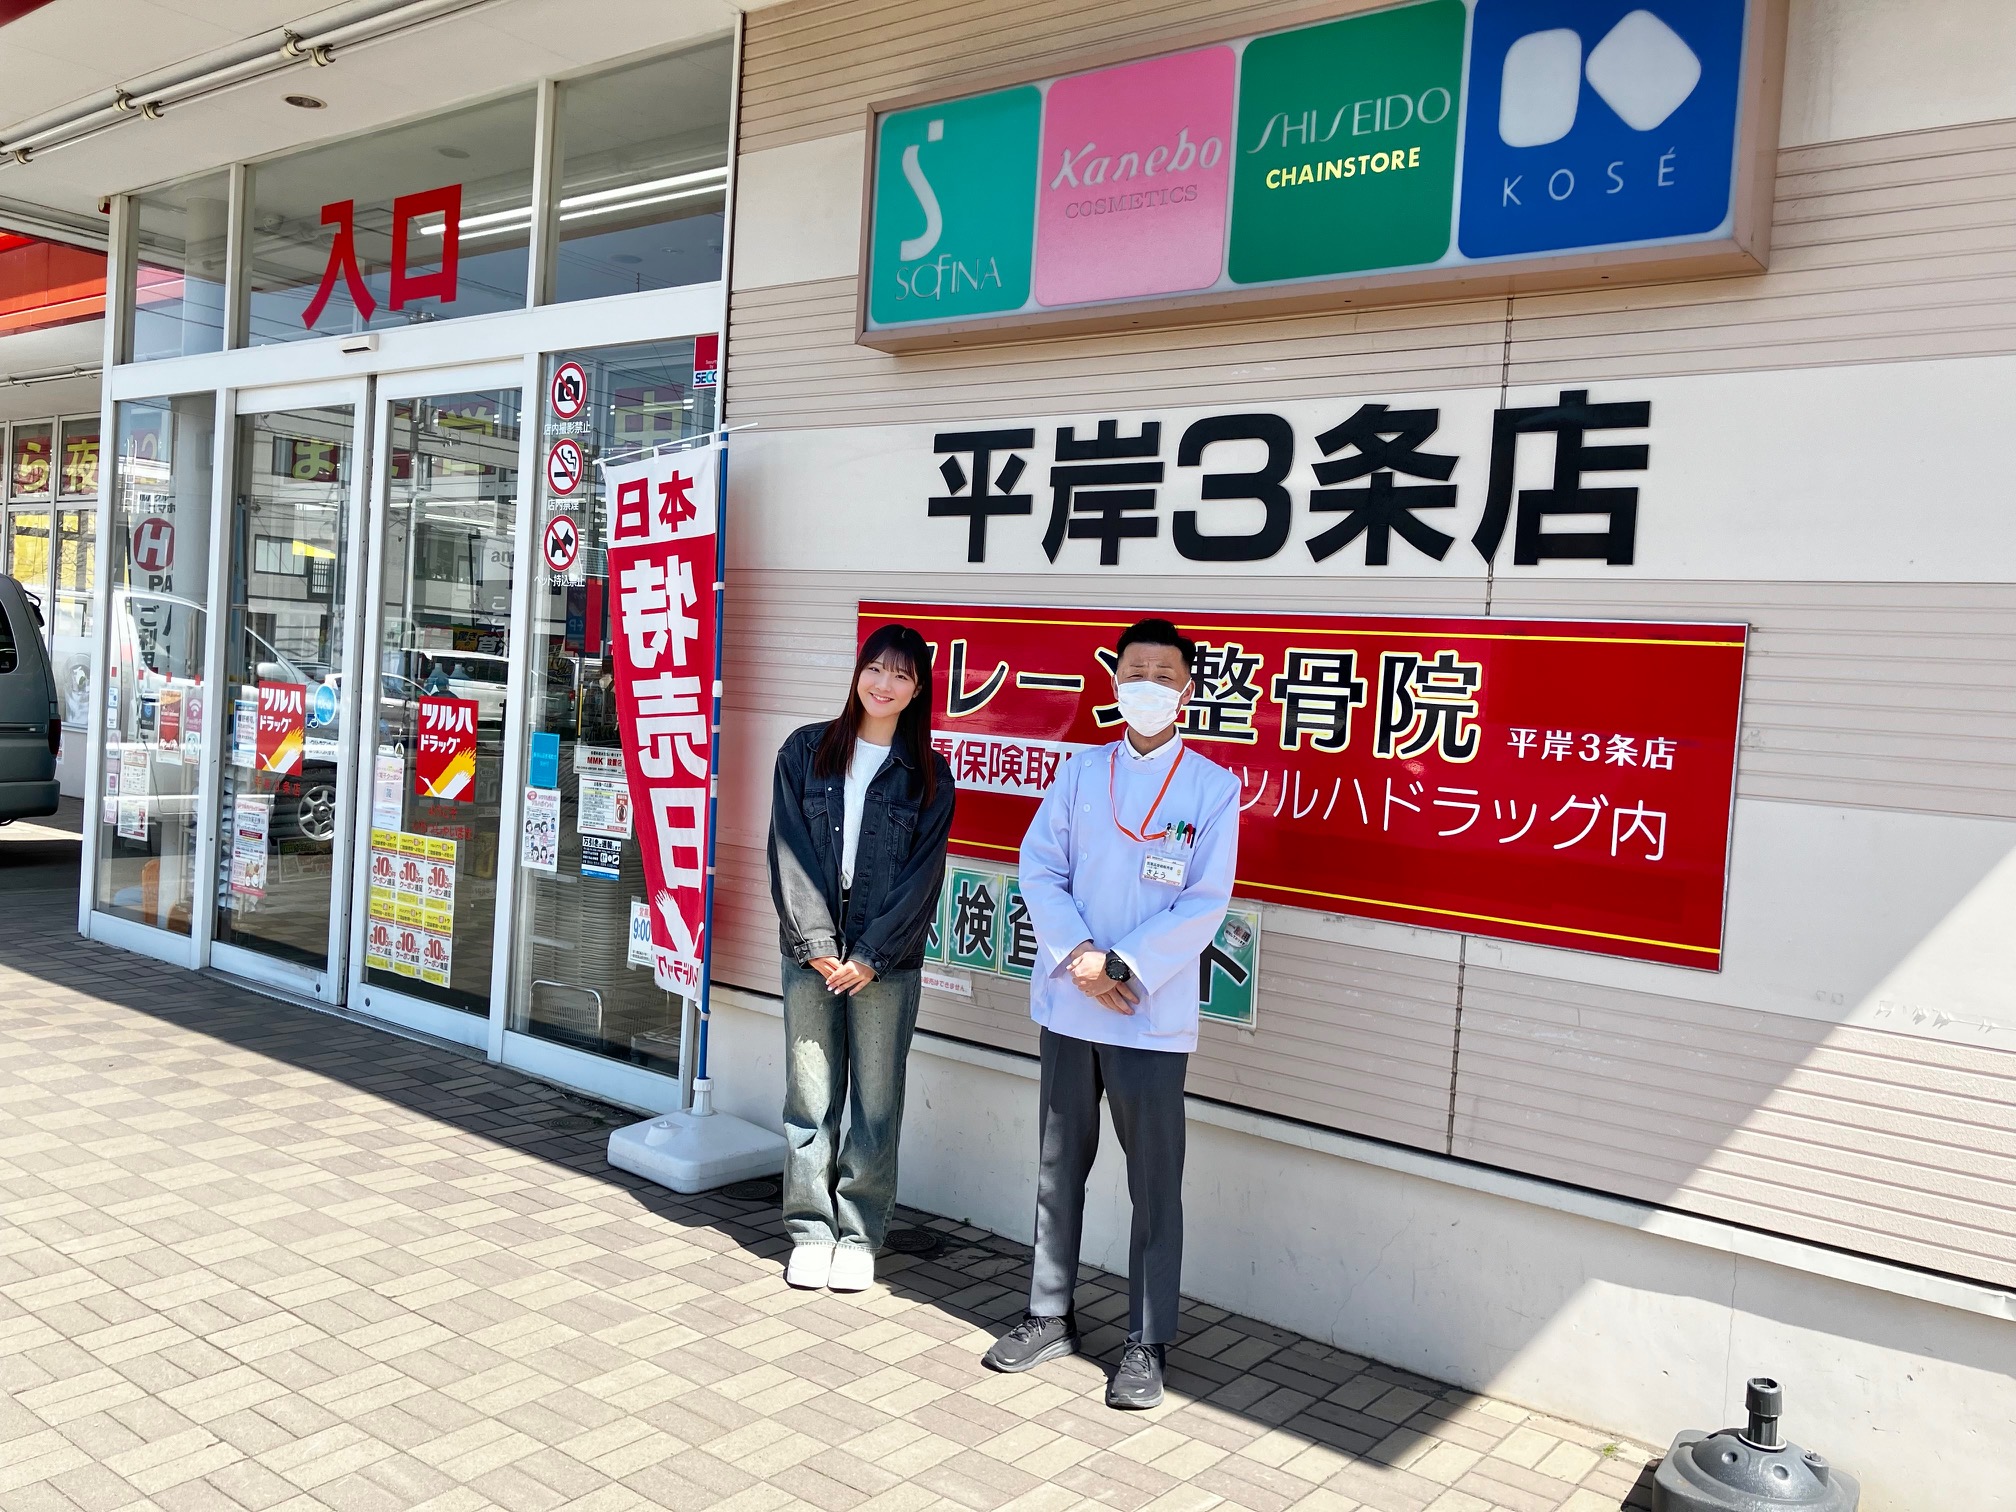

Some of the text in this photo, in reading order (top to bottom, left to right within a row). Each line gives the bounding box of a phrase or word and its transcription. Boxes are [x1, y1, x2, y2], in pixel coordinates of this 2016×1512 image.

[1247, 87, 1451, 154] SHISEIDO
[1049, 126, 1223, 191] Kanebo
[1265, 147, 1421, 189] CHAINSTORE
[1503, 147, 1677, 207] KOSÉ
[1065, 184, 1198, 219] COSMETICS
[301, 183, 462, 331] 入口
[895, 254, 1002, 301] SOFINA
[927, 390, 1651, 567] 平岸3条店
[260, 715, 292, 733] ドラッグ
[261, 687, 302, 715] ツルハ
[422, 703, 474, 734] ツルハ
[928, 637, 1483, 763] レー整骨院
[420, 734, 461, 754] ドラッグ
[587, 757, 604, 766] MMK
[931, 737, 1072, 791] 保険取
[1507, 727, 1677, 771] 平岸3条店
[1228, 766, 1667, 861] ツルハドラッグ内
[926, 881, 1038, 968] 検査
